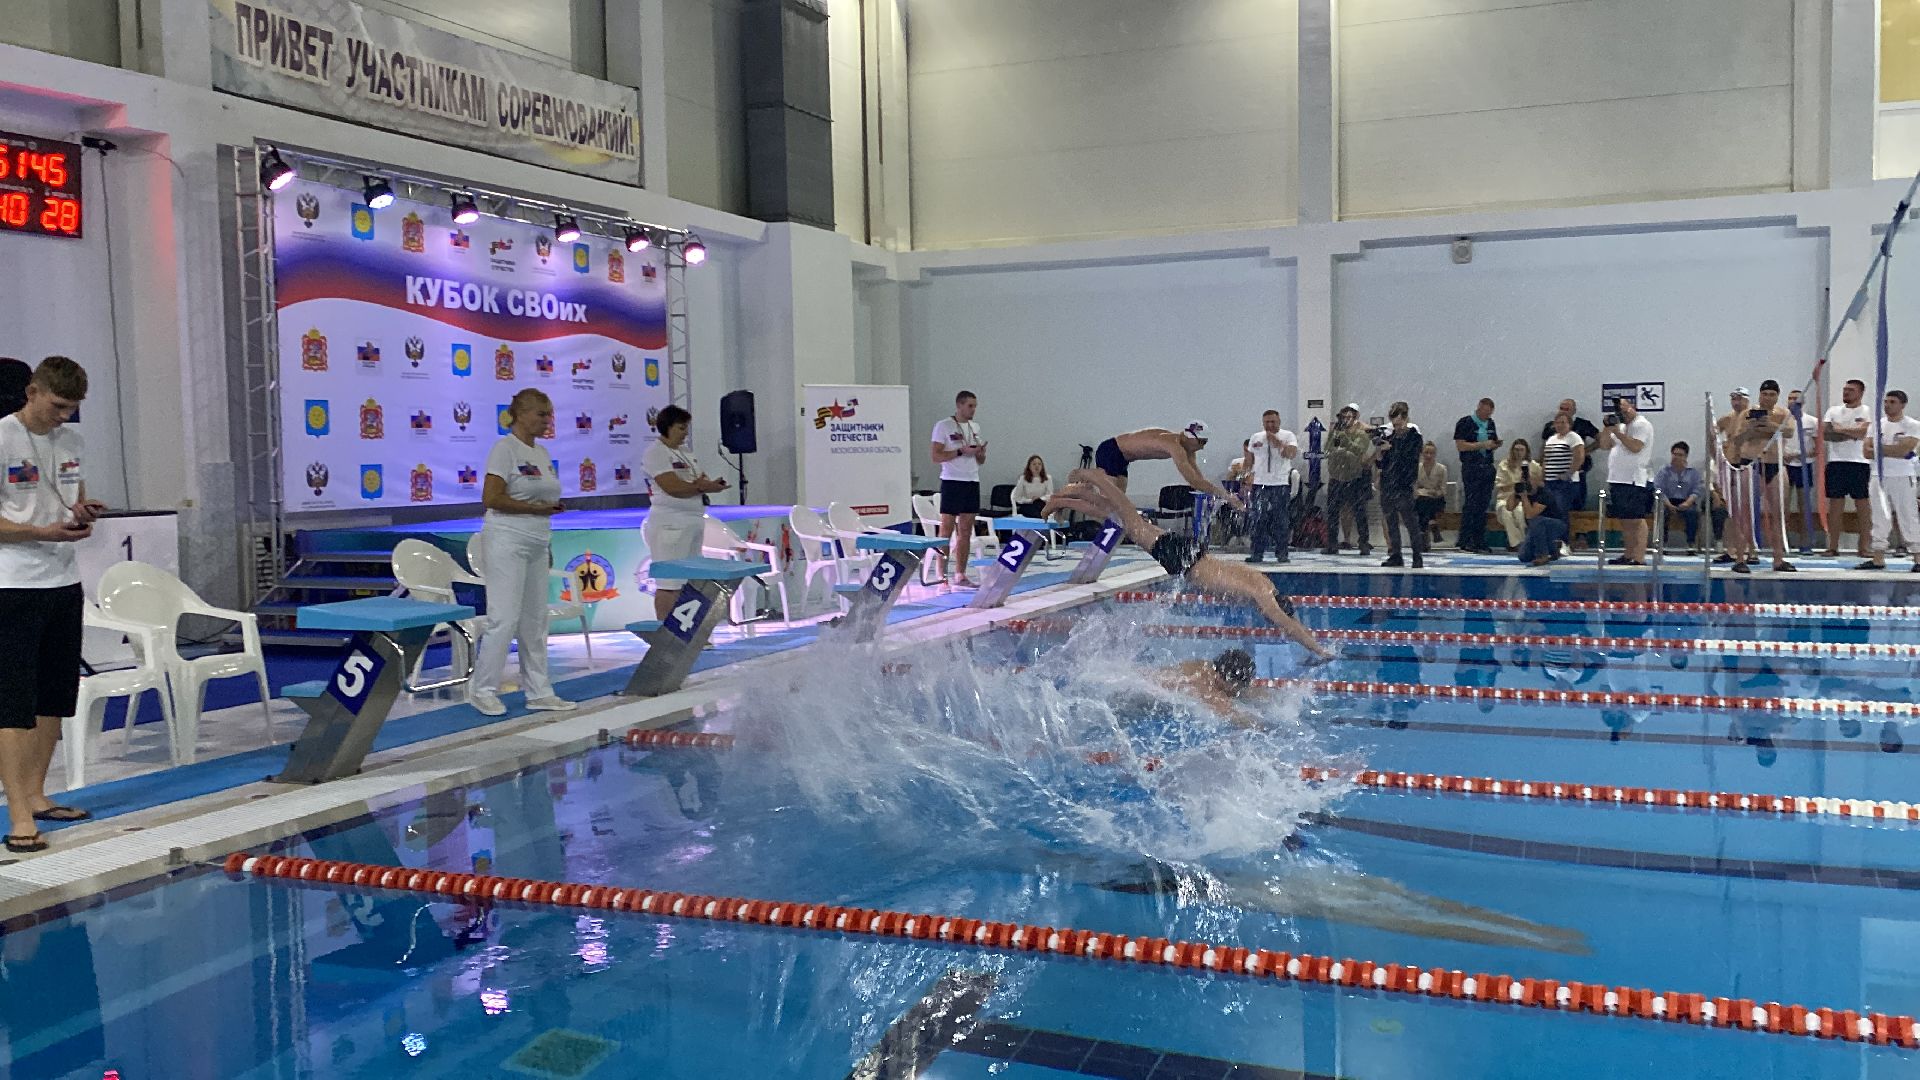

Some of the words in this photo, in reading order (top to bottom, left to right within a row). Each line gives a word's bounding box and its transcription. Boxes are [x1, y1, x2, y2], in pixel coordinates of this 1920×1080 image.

[235, 2, 333, 81] ПРИВЕТ
[346, 38, 487, 121] УЧАСТНИКАМ
[497, 81, 635, 156] СОРЕВНОВАНИЙ!
[41, 198, 79, 233] 28
[405, 275, 499, 314] КУБОК
[506, 289, 589, 323] СВОих
[830, 423, 885, 432] ЗАЩИТНИКИ
[830, 434, 878, 442] ОТЕЧЕСТВА
[121, 535, 133, 562] 1
[1100, 527, 1116, 547] 1
[1002, 540, 1025, 567] 2
[872, 561, 896, 591] 3
[672, 599, 702, 633] 4
[336, 649, 374, 698] 5
